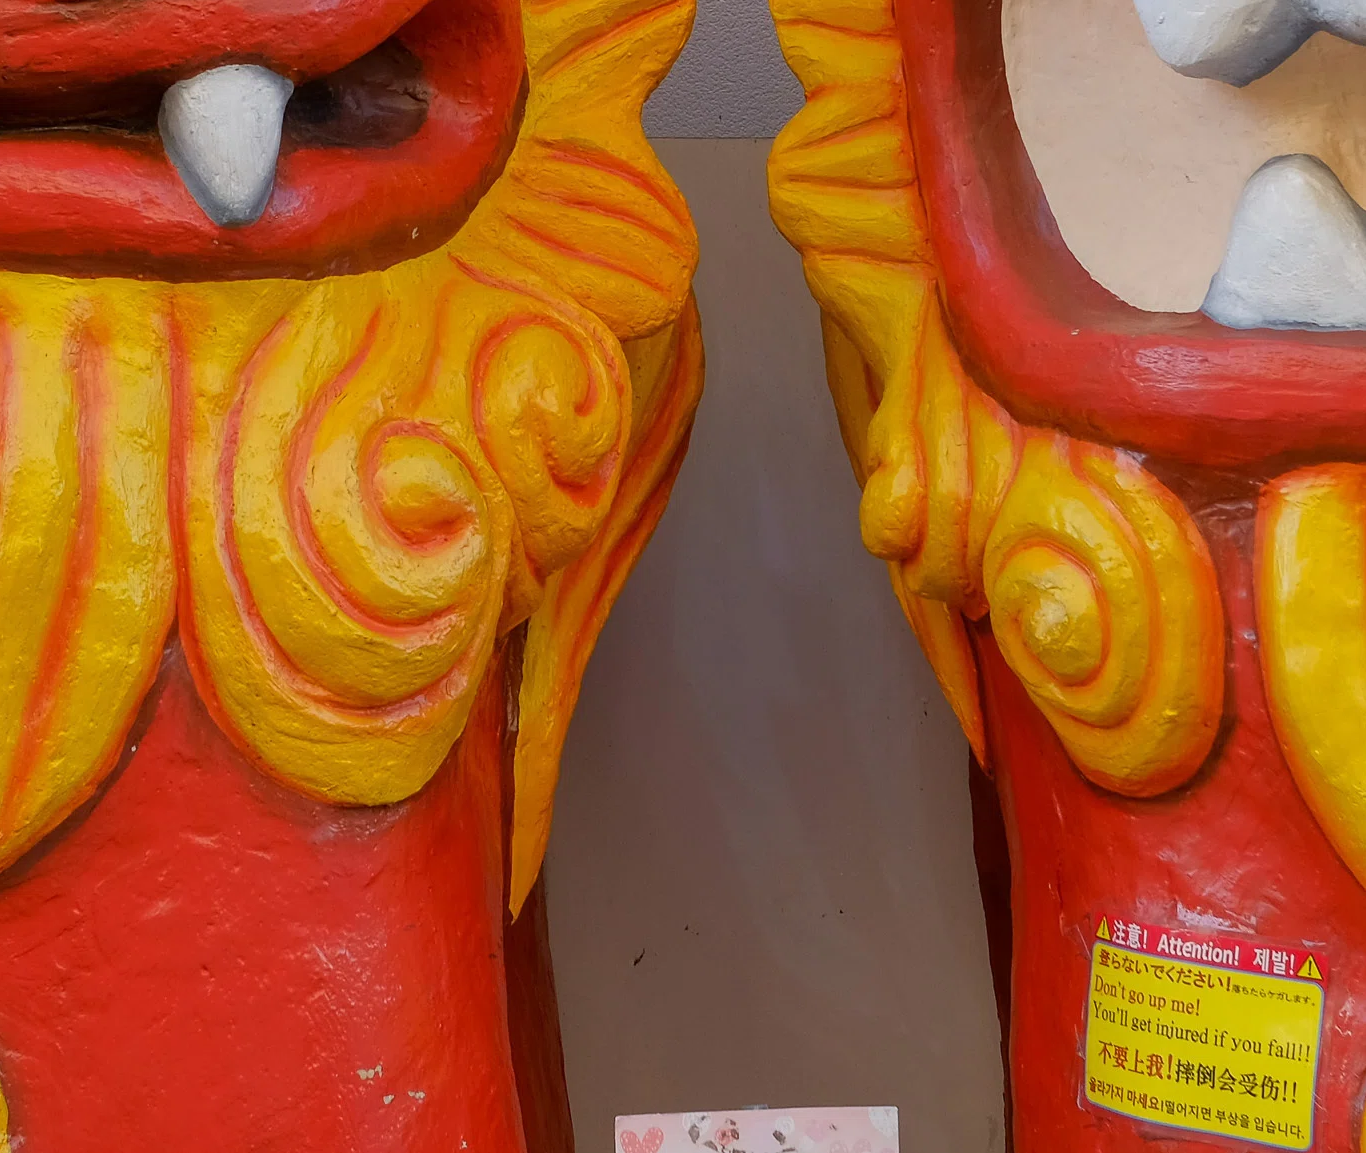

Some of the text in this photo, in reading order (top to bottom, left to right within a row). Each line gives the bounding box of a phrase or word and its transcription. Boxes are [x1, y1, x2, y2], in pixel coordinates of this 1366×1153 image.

[1112, 919, 1295, 976] 注意! Attention! 제발!
[1094, 974, 1200, 1016] Don't go up me!
[1093, 1000, 1311, 1063] You'll get injured if you fall!!
[1215, 1109, 1250, 1129] 부상을
